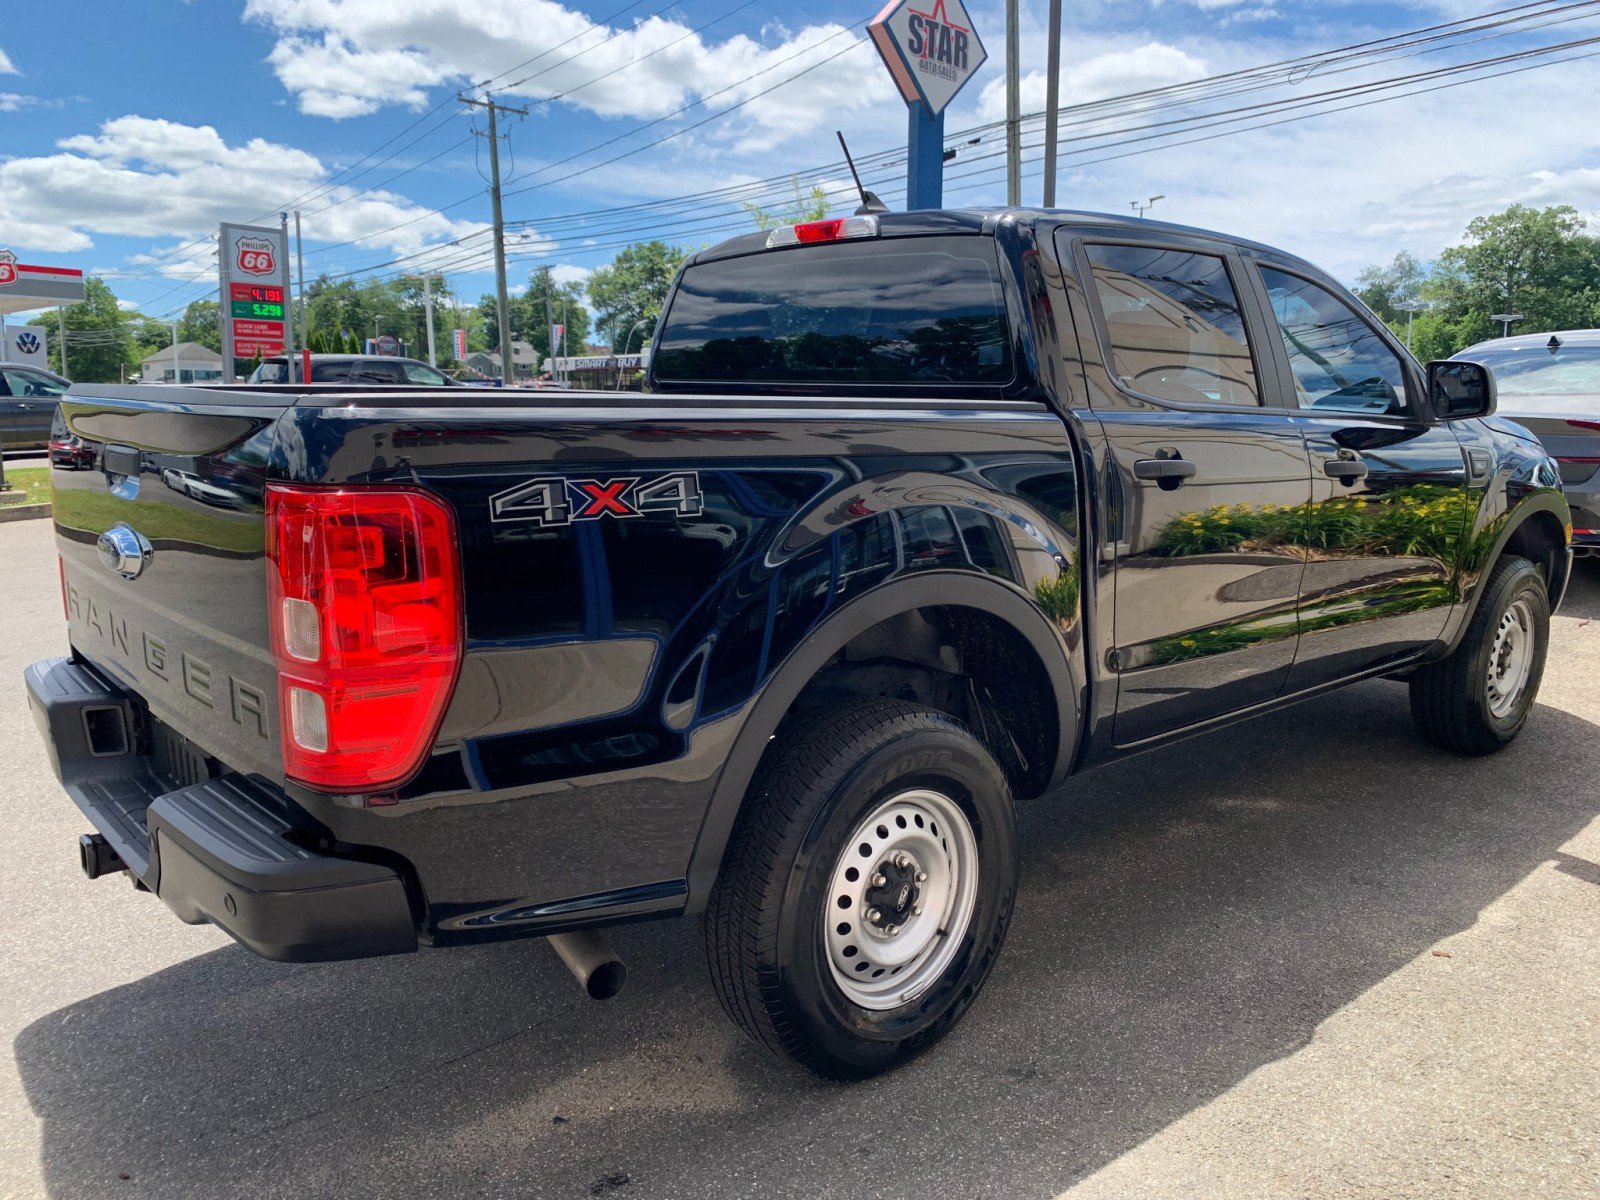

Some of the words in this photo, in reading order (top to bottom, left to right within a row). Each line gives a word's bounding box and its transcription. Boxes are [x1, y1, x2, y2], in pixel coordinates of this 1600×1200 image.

[908, 14, 968, 71] STAR
[920, 60, 937, 74] AUTO
[938, 65, 957, 80] SALES
[241, 241, 270, 251] PHILLIPS
[244, 253, 269, 269] 66
[576, 359, 608, 368] SMART
[617, 357, 638, 367] BUY
[489, 471, 704, 527] 4X4
[66, 580, 271, 741] RANGER
